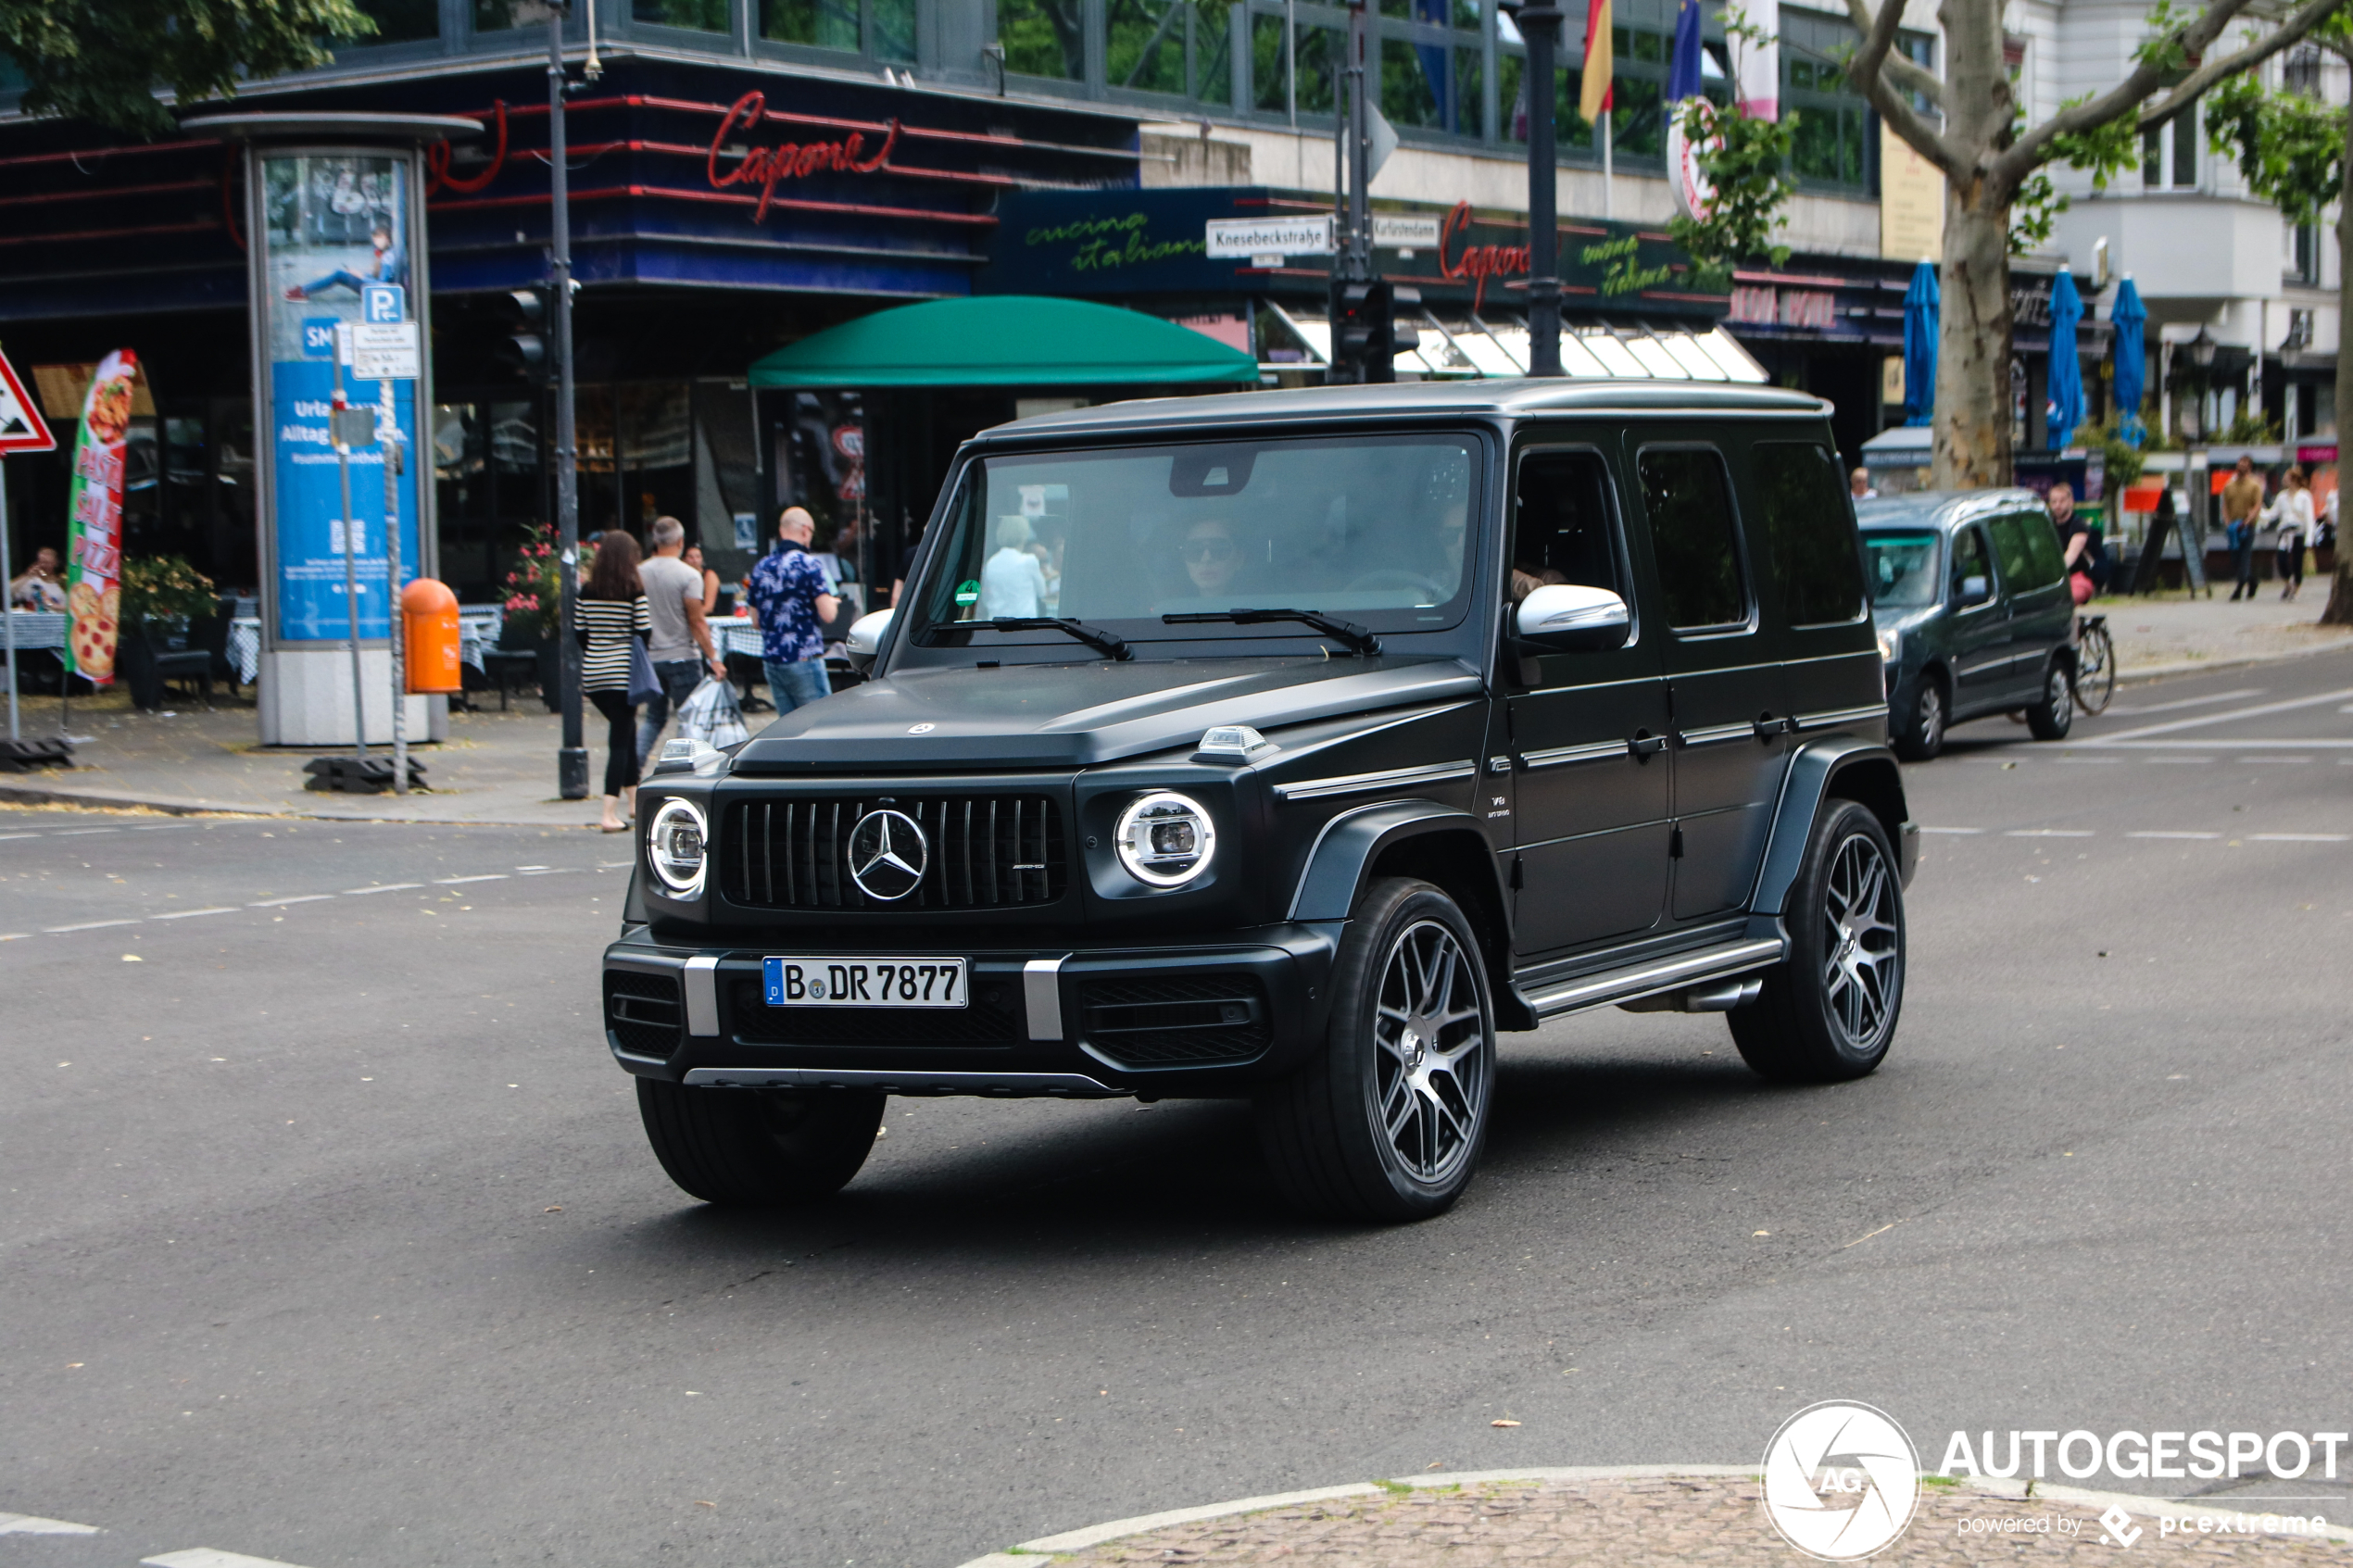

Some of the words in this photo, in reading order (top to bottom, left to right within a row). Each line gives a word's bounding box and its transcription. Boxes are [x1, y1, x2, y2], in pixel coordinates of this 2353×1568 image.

[707, 89, 901, 224] Capone
[1071, 229, 1206, 271] italian
[1216, 230, 1322, 248] Knesebeckstraße
[74, 445, 123, 494] PASTA
[70, 533, 121, 582] PIZZA
[785, 964, 806, 999] B
[827, 964, 871, 1000] DR
[876, 964, 959, 1000] 7877
